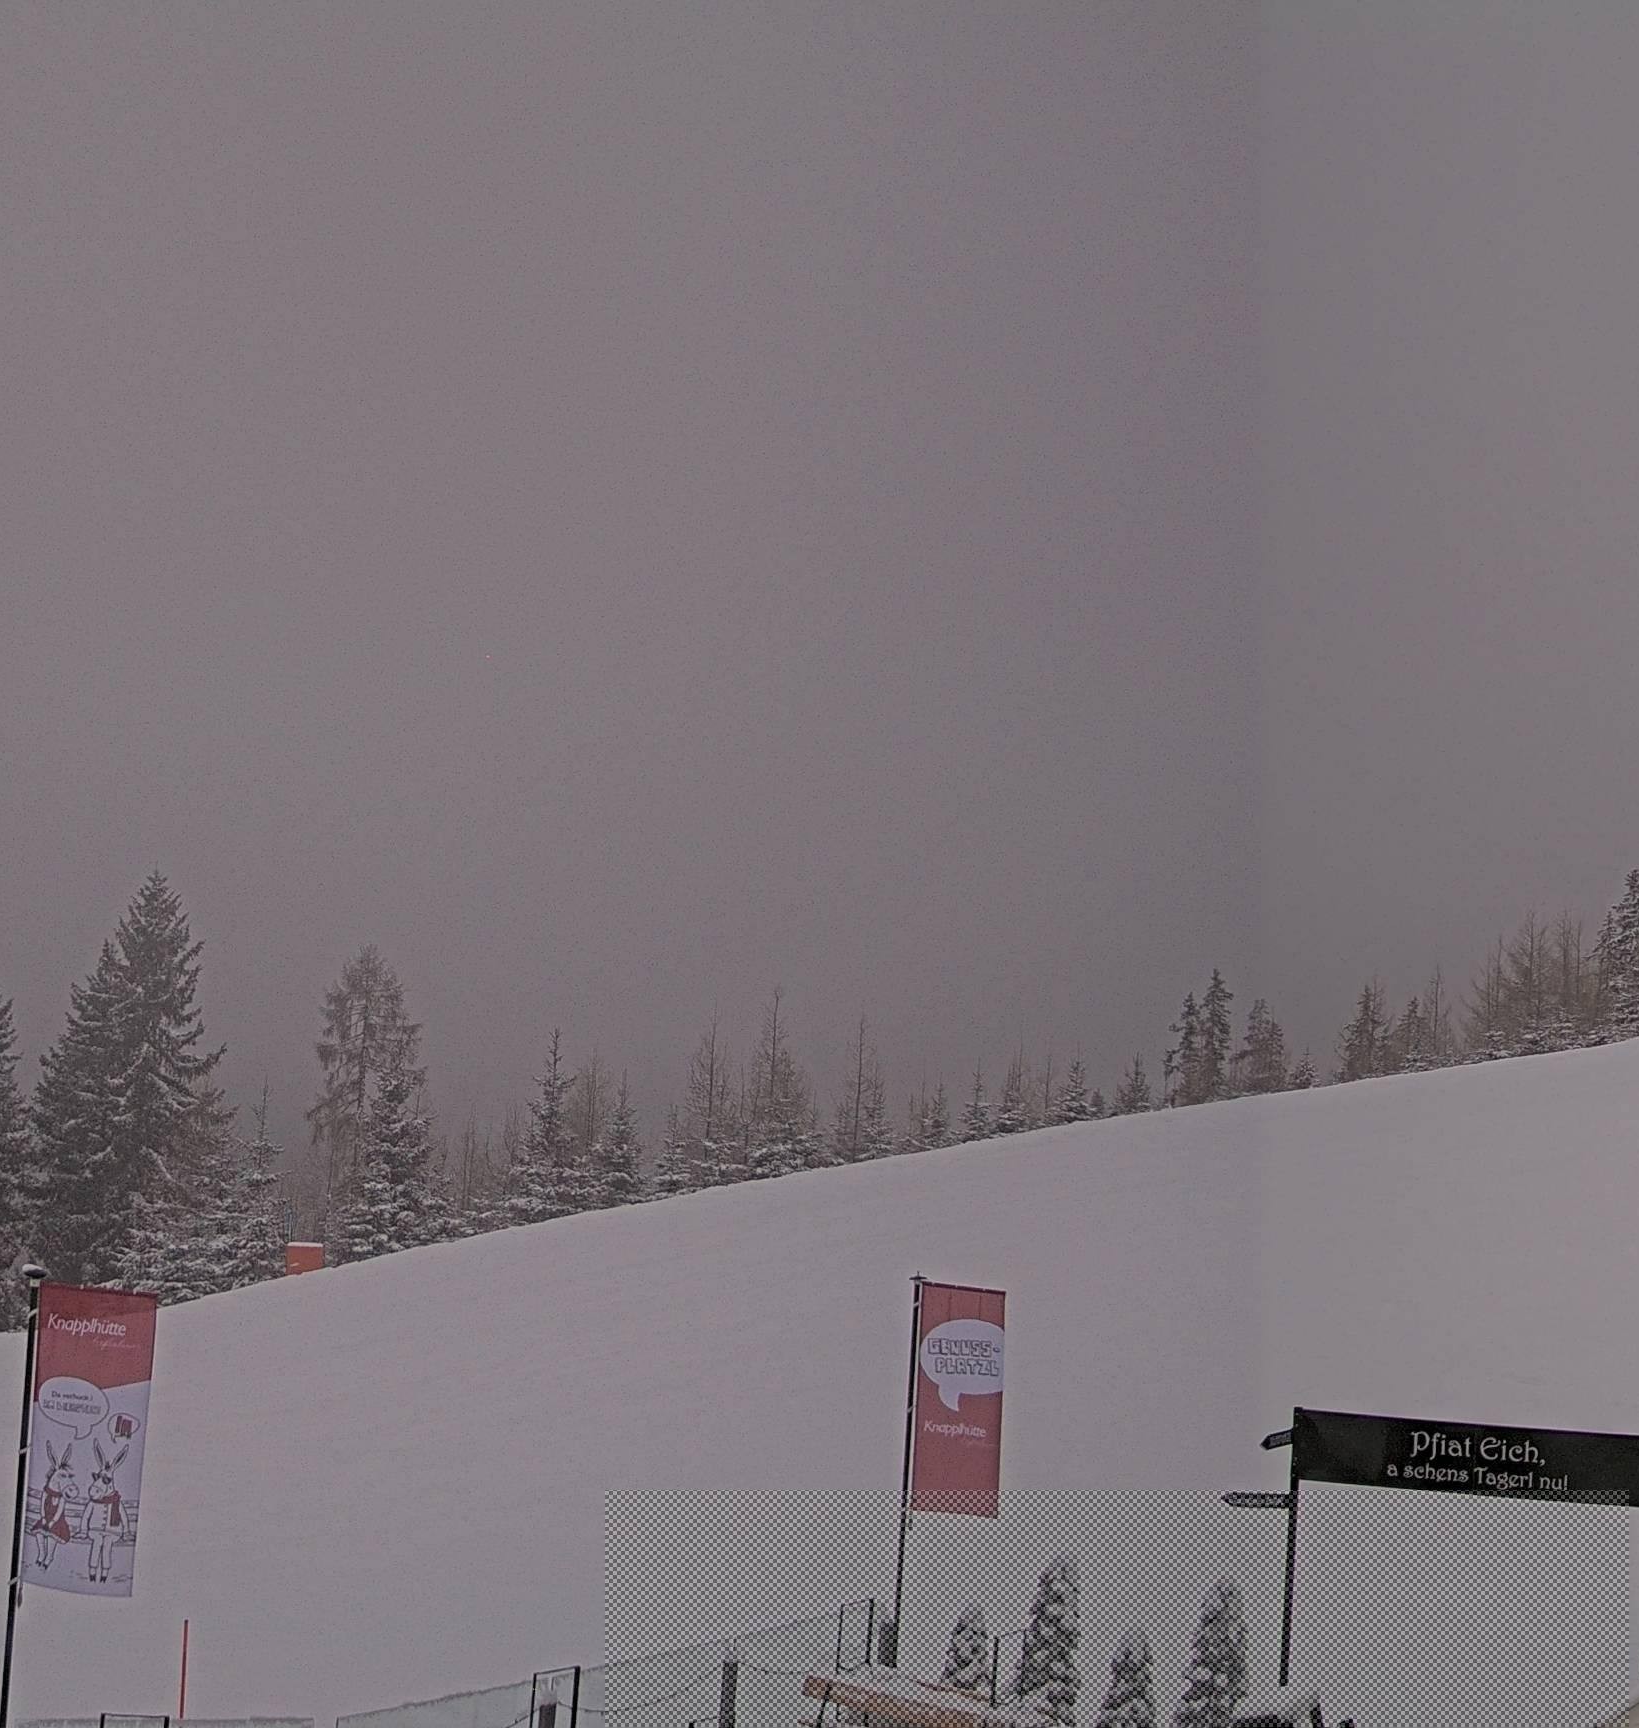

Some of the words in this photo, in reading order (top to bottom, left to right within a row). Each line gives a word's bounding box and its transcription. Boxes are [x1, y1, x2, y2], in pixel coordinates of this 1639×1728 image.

[47, 1312, 126, 1337] Knapplhütte
[934, 1357, 1000, 1377] PLATZL
[923, 1420, 987, 1438] Knapplhütte
[1409, 1430, 1473, 1461] Pfiat
[1480, 1436, 1546, 1467] Eich,
[1387, 1463, 1398, 1477] a
[1403, 1462, 1469, 1483] schens
[1473, 1466, 1533, 1490] Tagerl
